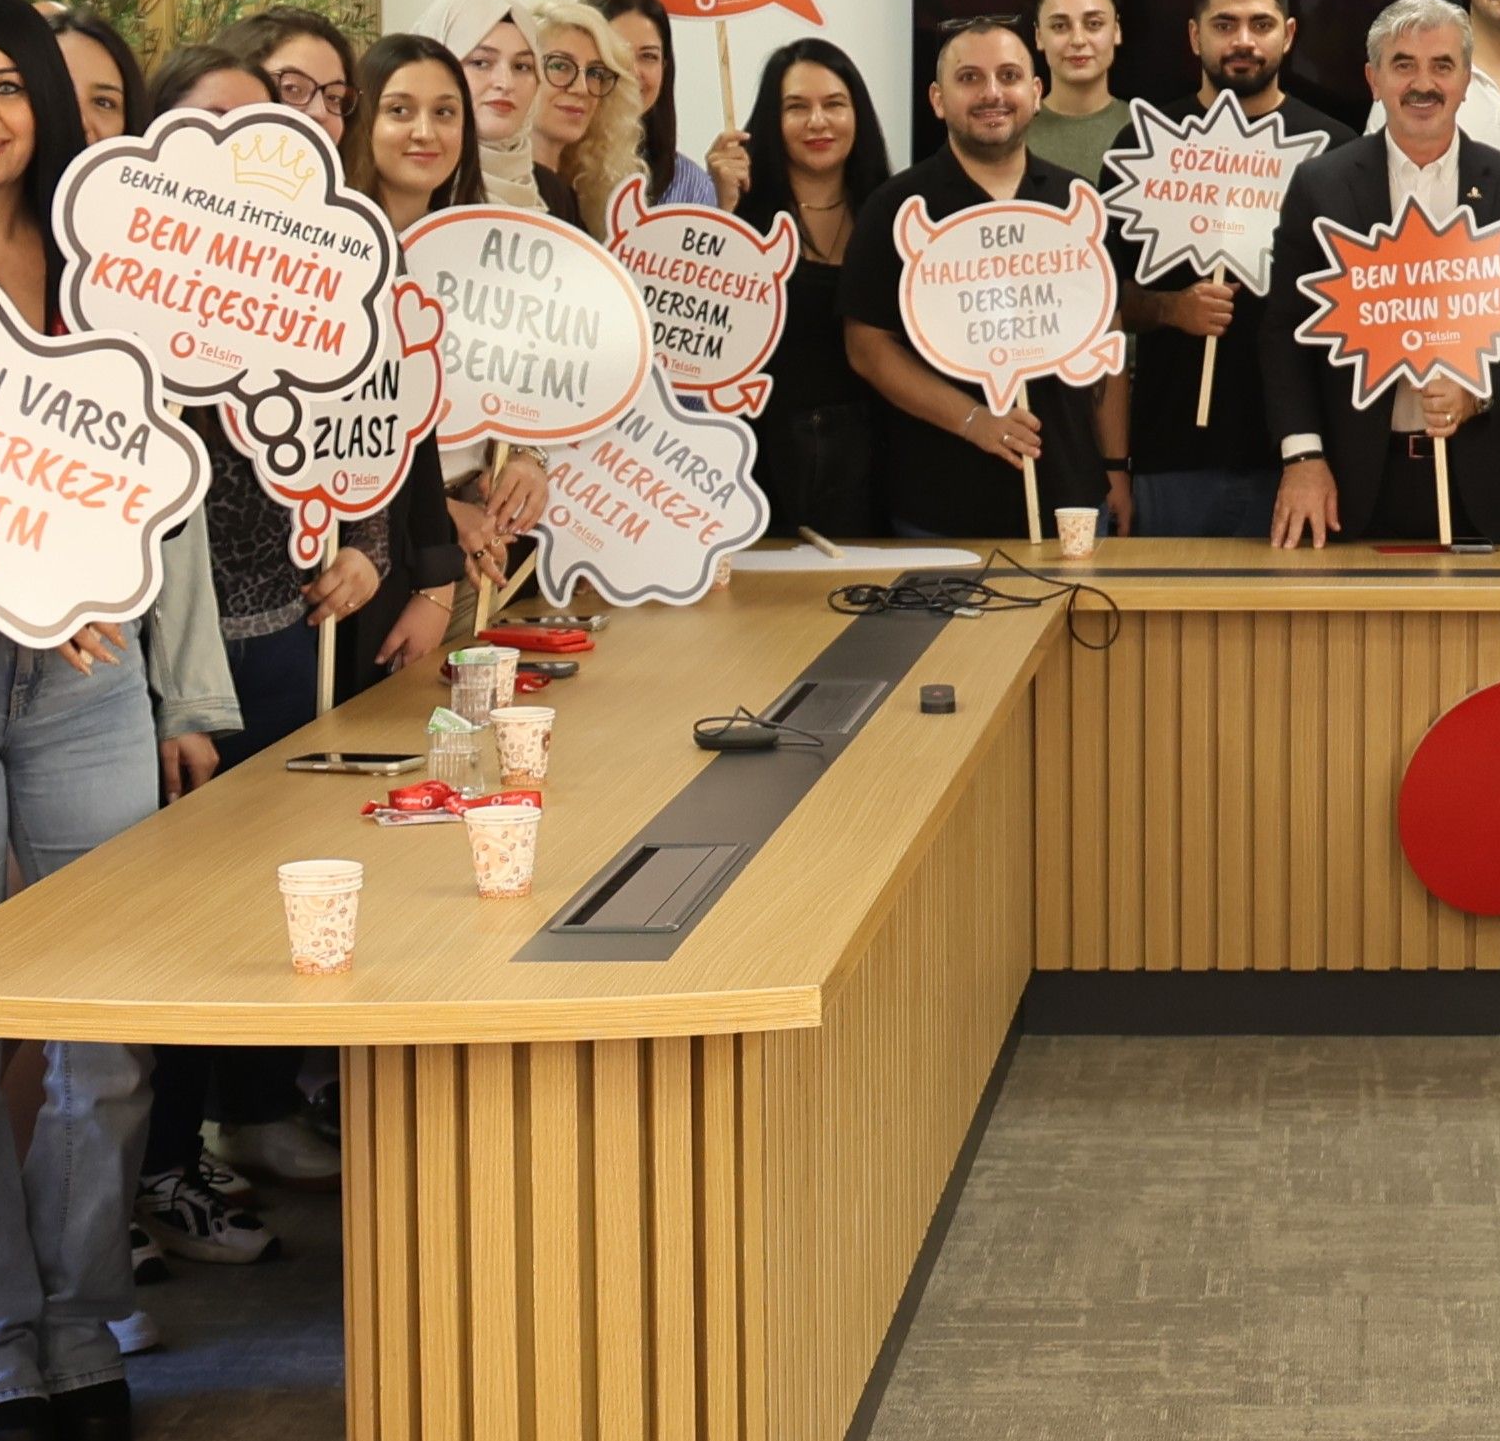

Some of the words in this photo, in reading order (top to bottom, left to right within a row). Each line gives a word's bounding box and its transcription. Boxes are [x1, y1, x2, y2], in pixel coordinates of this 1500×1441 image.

[1170, 142, 1282, 178] ÇÖZÜMÜN
[119, 165, 180, 200] BENİM
[182, 186, 235, 217] KRALA
[238, 200, 337, 249] İHTİYACIM
[338, 235, 374, 261] YOK
[1143, 178, 1220, 206] KADAR
[127, 207, 201, 255] BEN
[205, 232, 342, 302] MH'NİN
[681, 227, 726, 257] BEN
[979, 223, 1025, 249] BEN
[479, 228, 563, 292] ALO,
[618, 244, 772, 305] HALLEDECEYİK
[920, 243, 1092, 285] HALLEDECEYİK
[1351, 263, 1397, 290] BEN
[90, 252, 346, 356] KRALİÇESİYİM
[436, 271, 599, 350] BUYRUN
[643, 285, 733, 334] DERSAM,
[957, 282, 1063, 314] DERSAM,
[1359, 296, 1438, 326] SORUN
[1447, 287, 1500, 320] YOK!
[653, 322, 724, 359] DERİM
[966, 309, 1060, 345] EDERİM
[1424, 331, 1461, 341] Telsim
[199, 341, 243, 366] Telsim
[444, 331, 589, 408] BENİM!
[20, 375, 151, 466] VARSA
[313, 414, 399, 460] ZLASI
[652, 430, 736, 509] VARSA
[548, 462, 649, 544] ALALIM
[591, 440, 724, 546] MERKEZ'E
